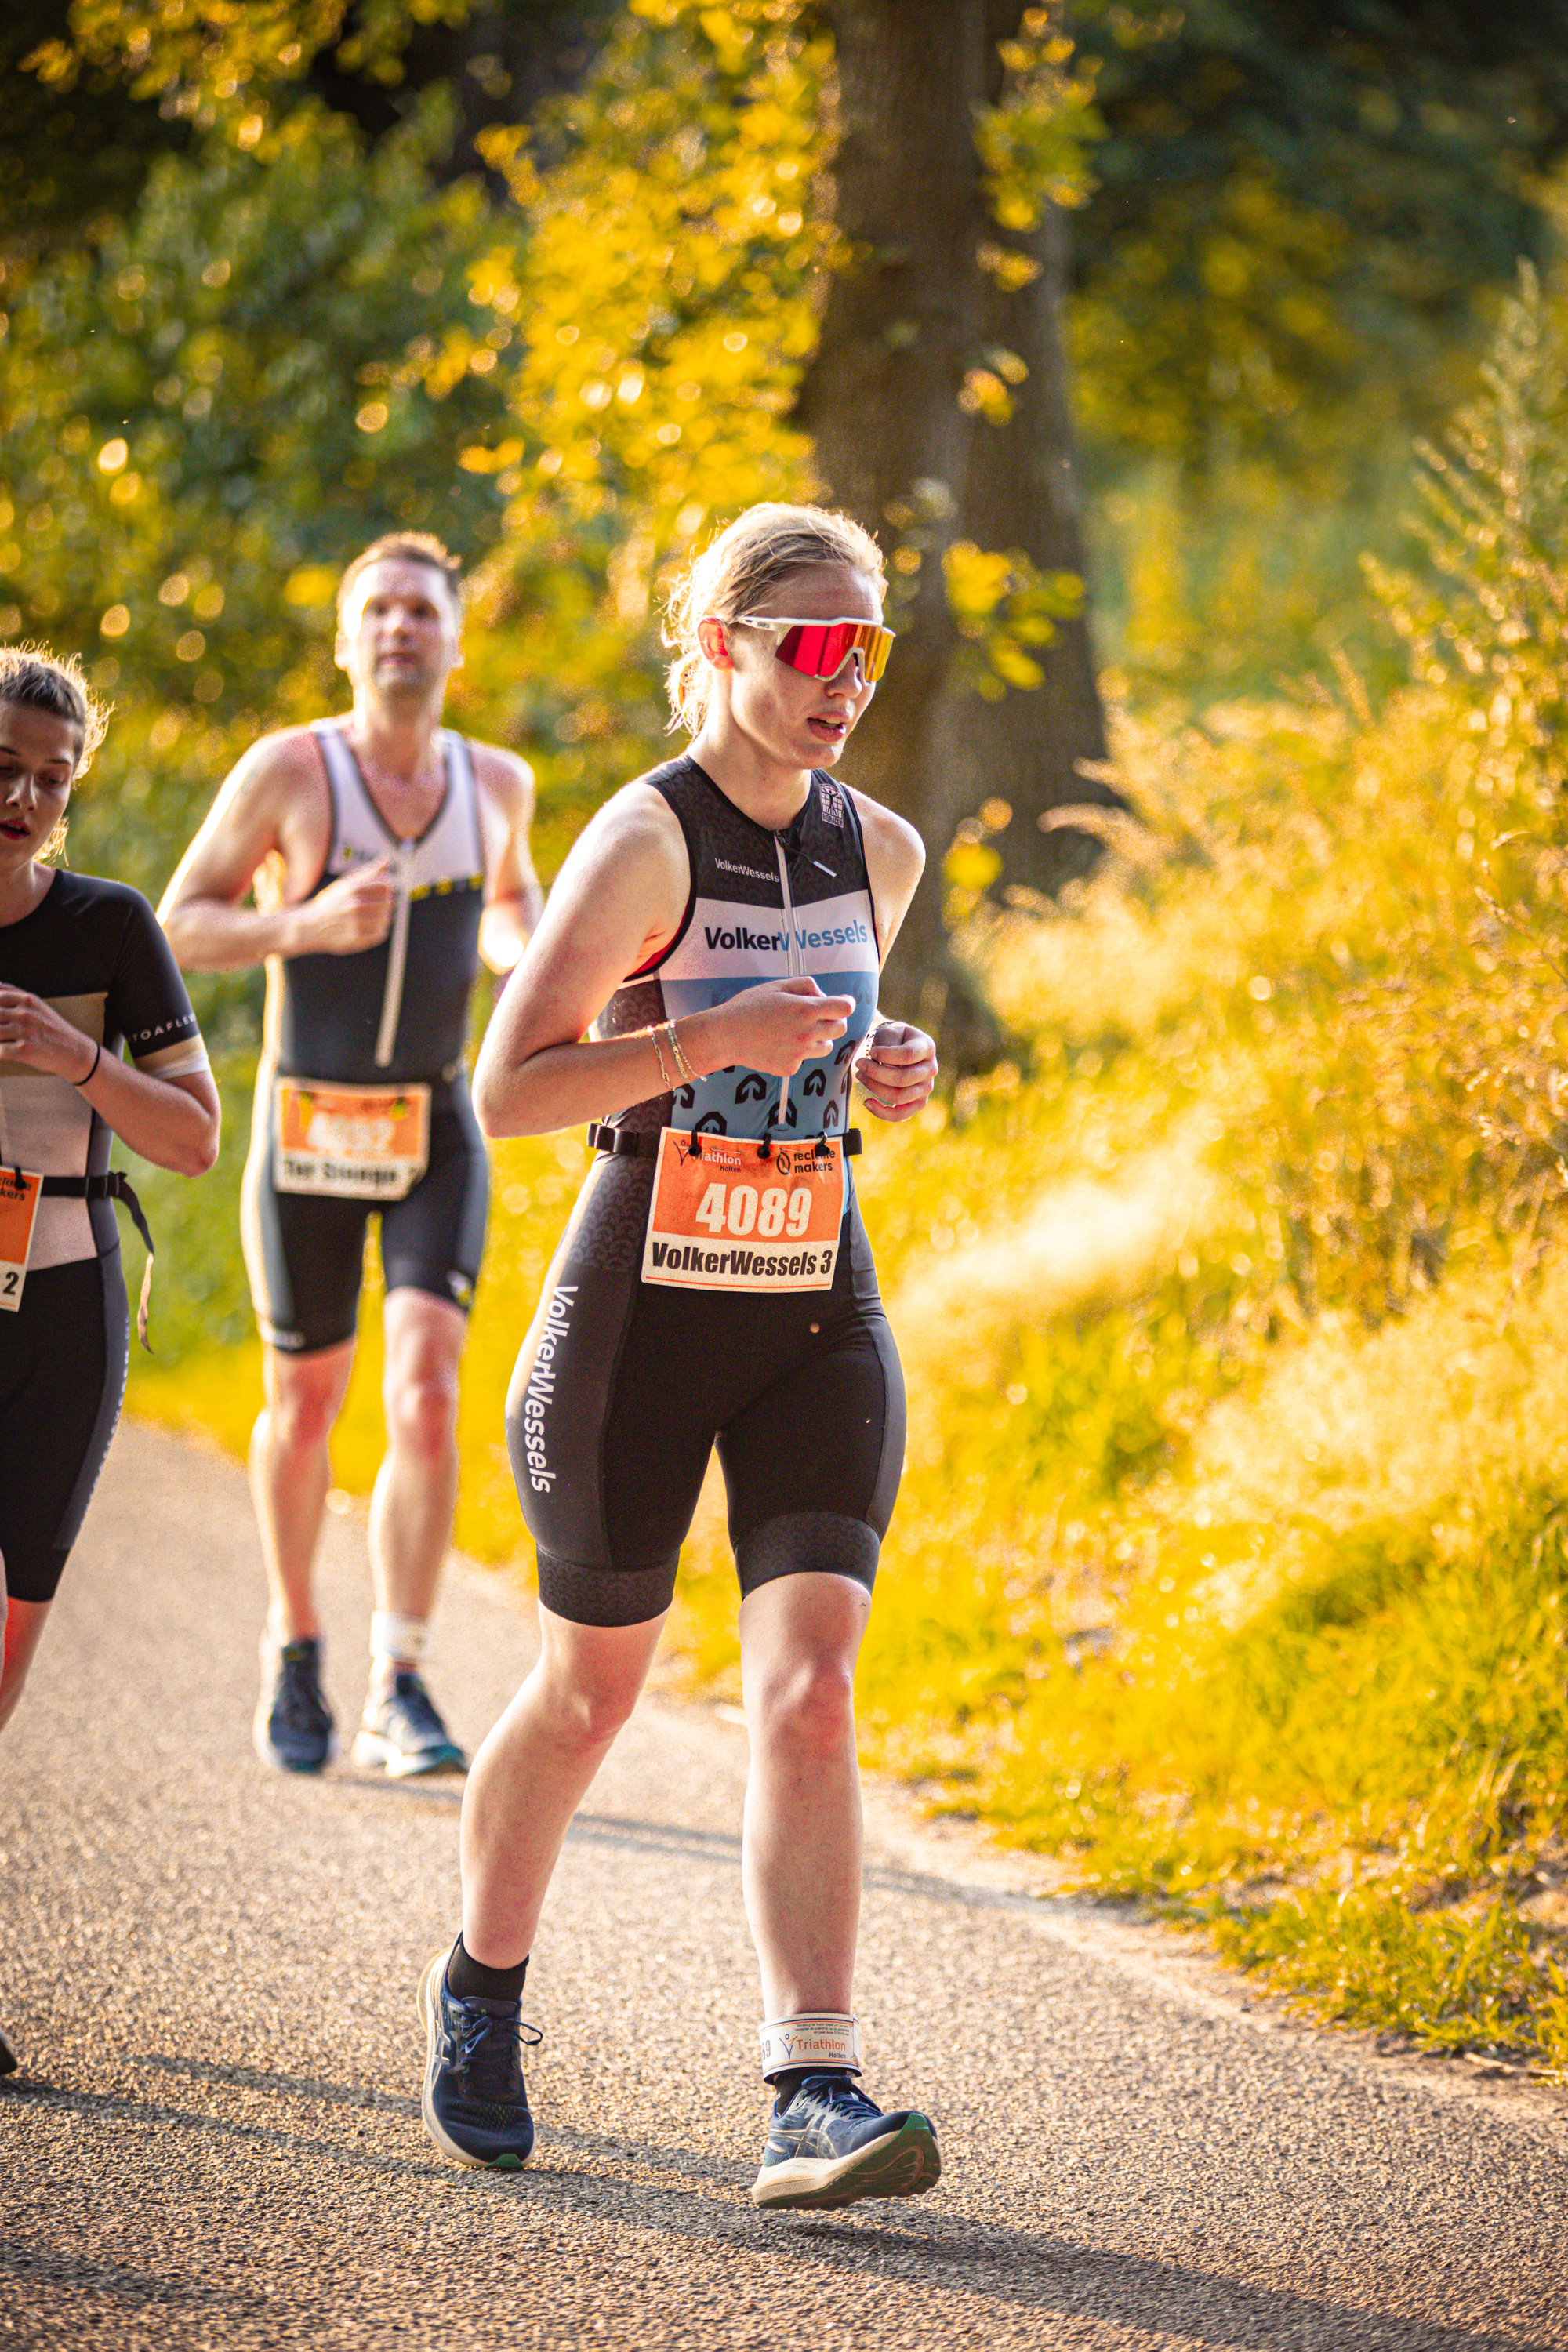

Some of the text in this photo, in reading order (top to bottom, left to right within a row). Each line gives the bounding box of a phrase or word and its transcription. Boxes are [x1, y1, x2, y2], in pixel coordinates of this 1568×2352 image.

[715, 858, 780, 883] VolkerWessels
[704, 920, 867, 951] VolkerWessels
[692, 1149, 741, 1165] riathlon
[793, 1149, 836, 1161] recle
[794, 1161, 833, 1174] makers
[695, 1182, 812, 1237] 4089
[652, 1242, 833, 1276] VolkerWessels 3
[3, 1272, 20, 1295] 2
[524, 1286, 579, 1494] VolkerWessels
[797, 2038, 846, 2051] Triathlon
